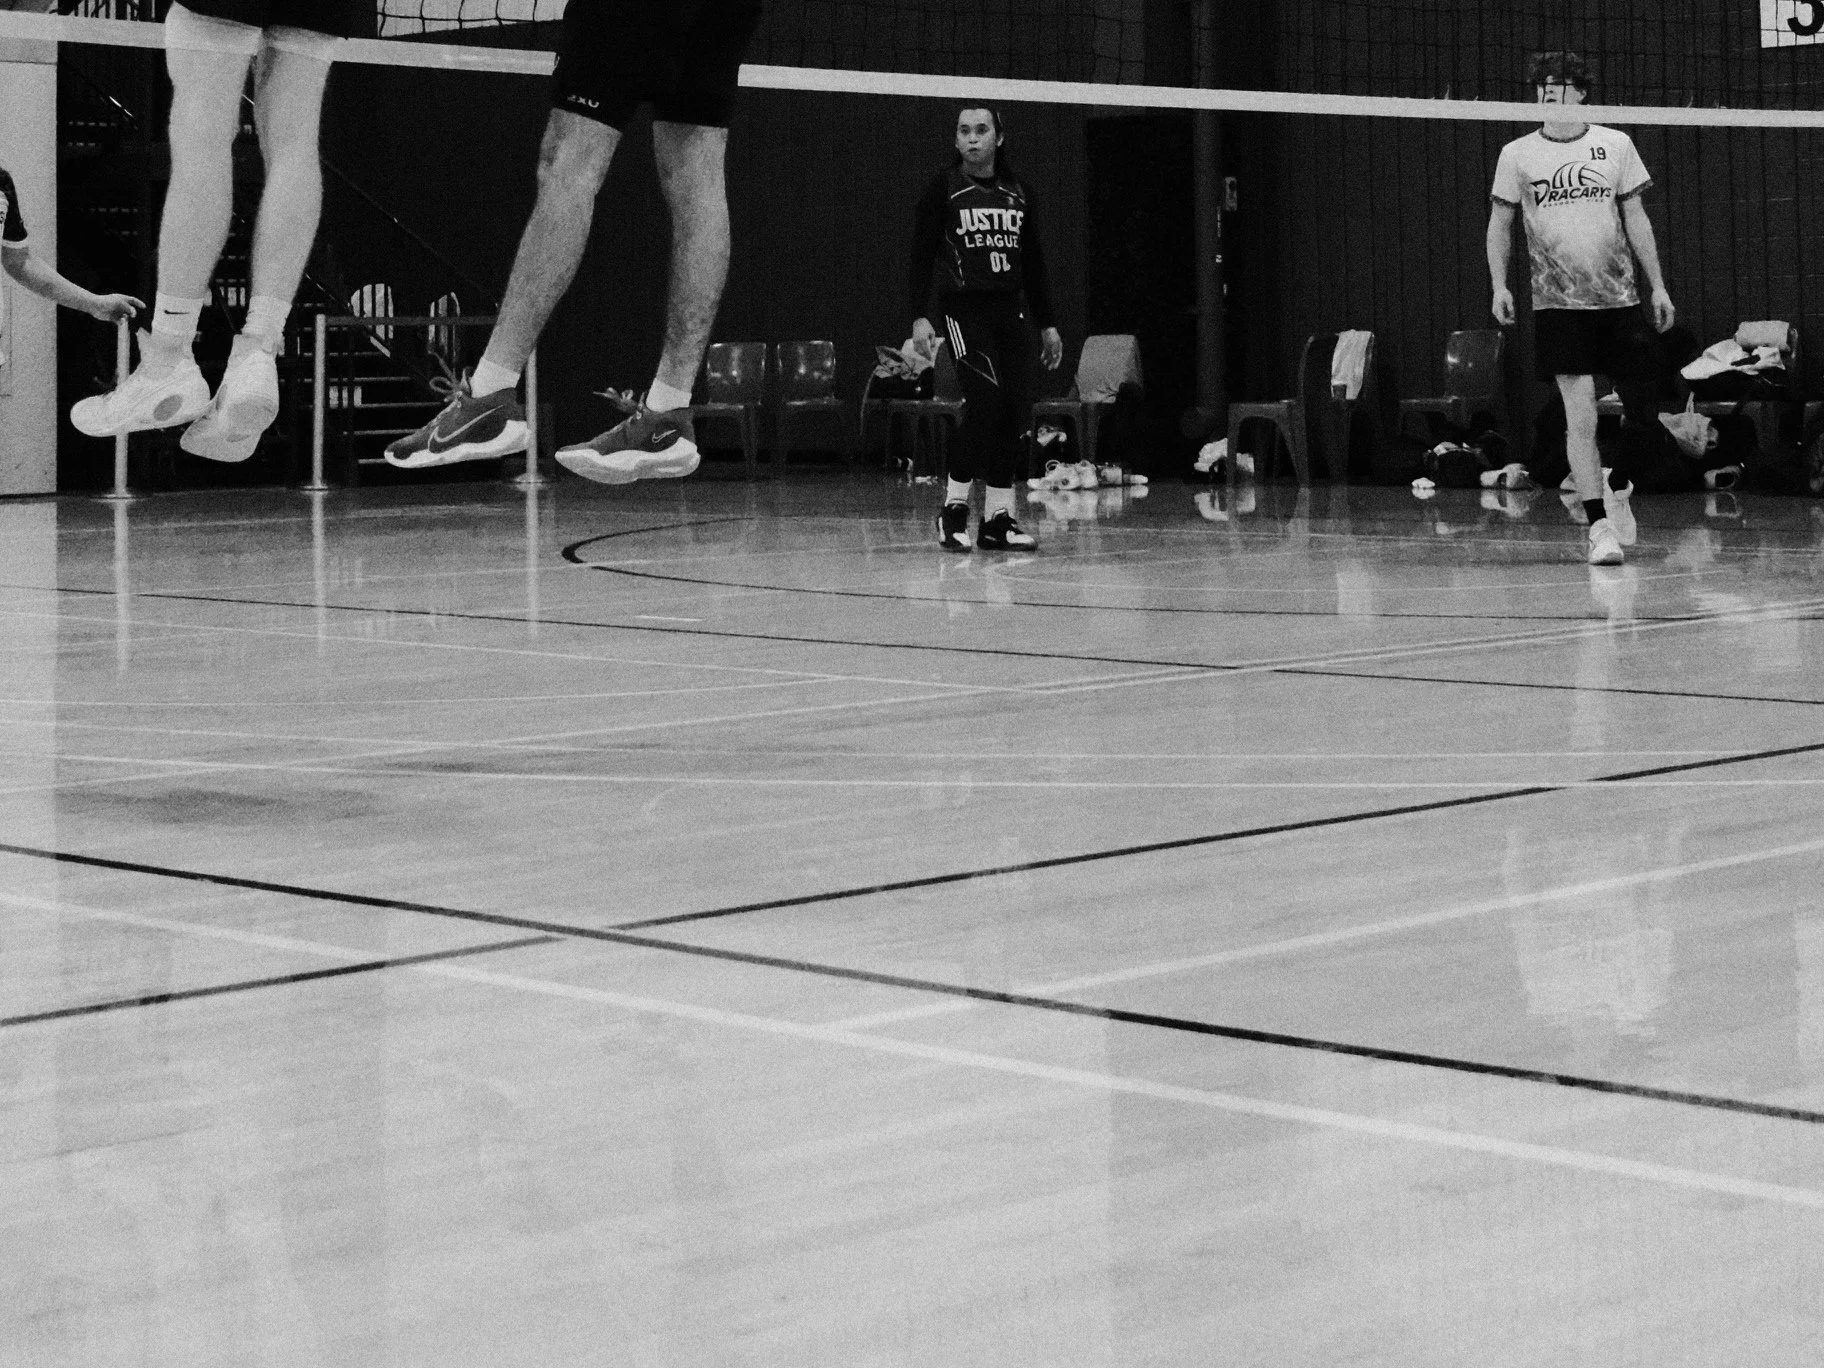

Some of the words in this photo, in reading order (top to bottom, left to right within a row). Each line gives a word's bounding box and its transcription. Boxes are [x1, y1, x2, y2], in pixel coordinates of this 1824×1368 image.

[1589, 146, 1607, 160] 19
[1530, 179, 1612, 206] DRACARYS
[964, 233, 1019, 248] LEAGUE
